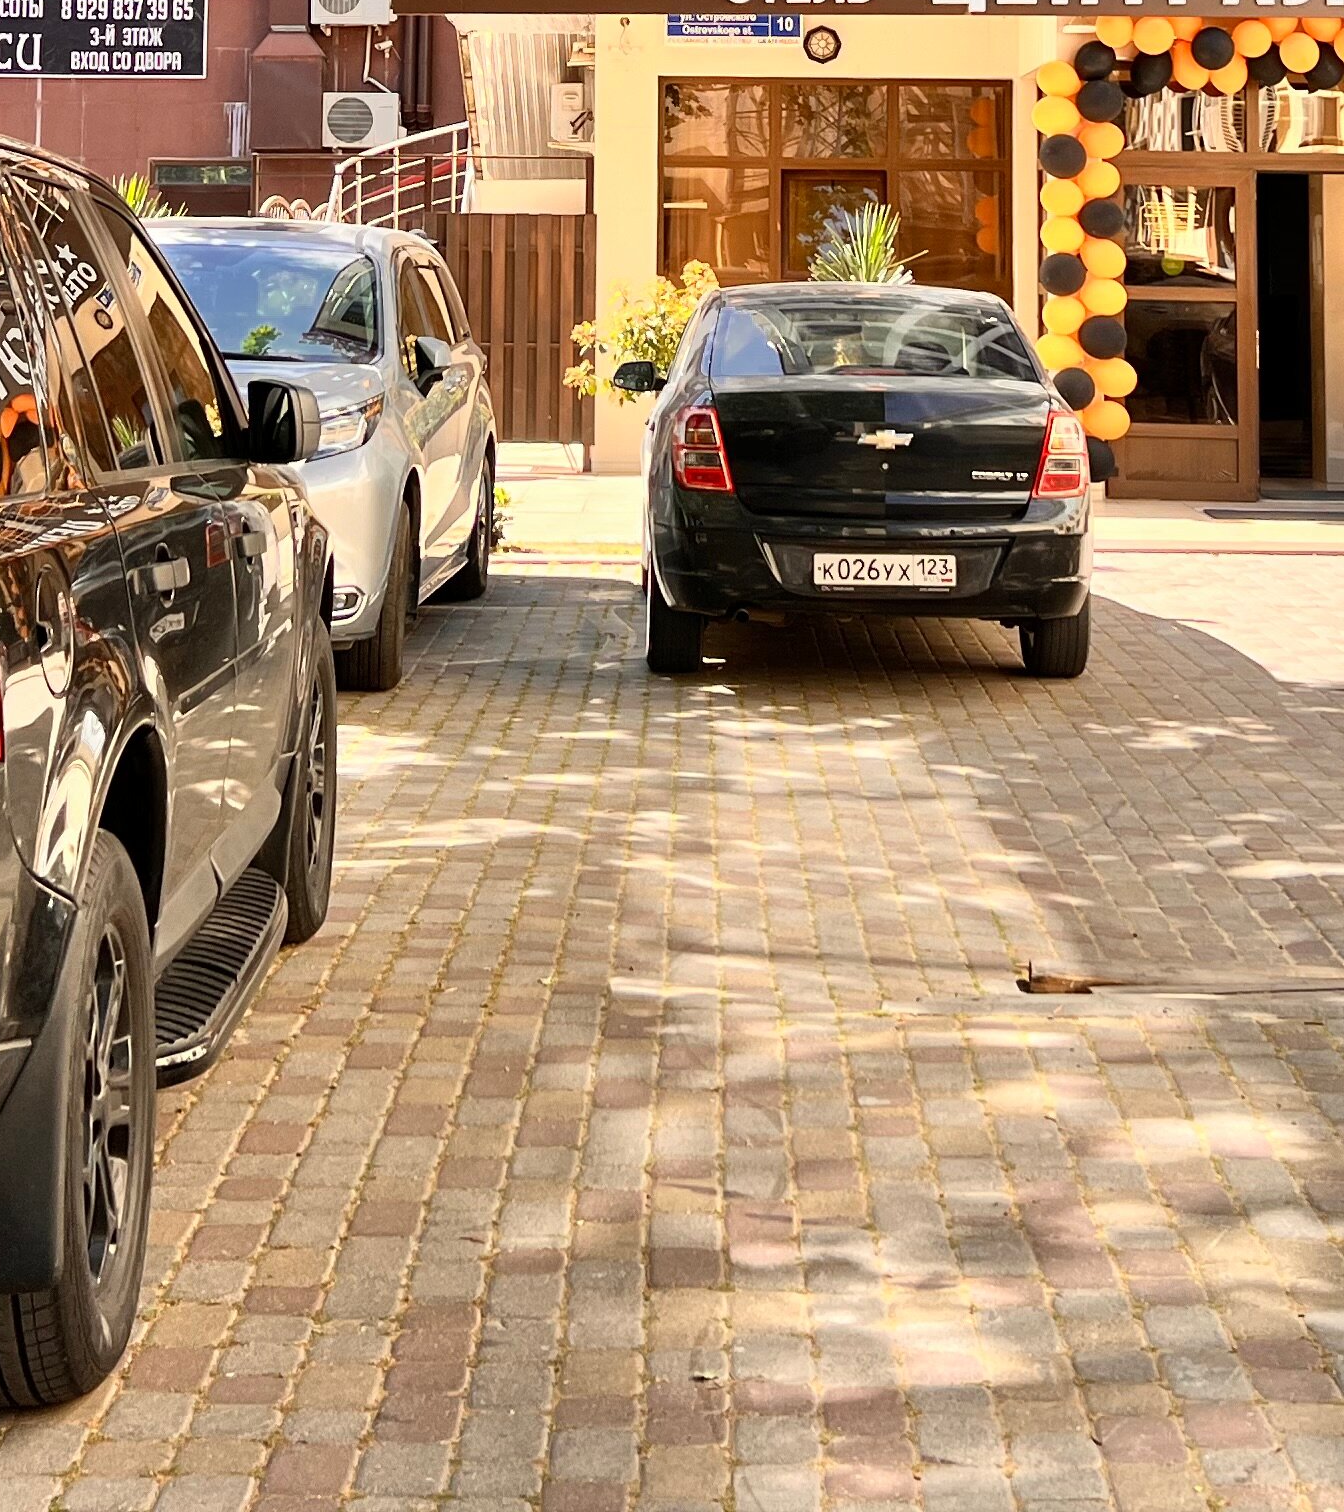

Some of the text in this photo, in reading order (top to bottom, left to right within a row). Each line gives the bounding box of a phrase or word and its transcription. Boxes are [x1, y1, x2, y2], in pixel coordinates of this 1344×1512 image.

[776, 16, 794, 32] 10
[122, 27, 164, 47] ЭТАЖ
[70, 50, 182, 72] ВХОД СО ДВОРА
[822, 558, 949, 581] К026УХ 123
